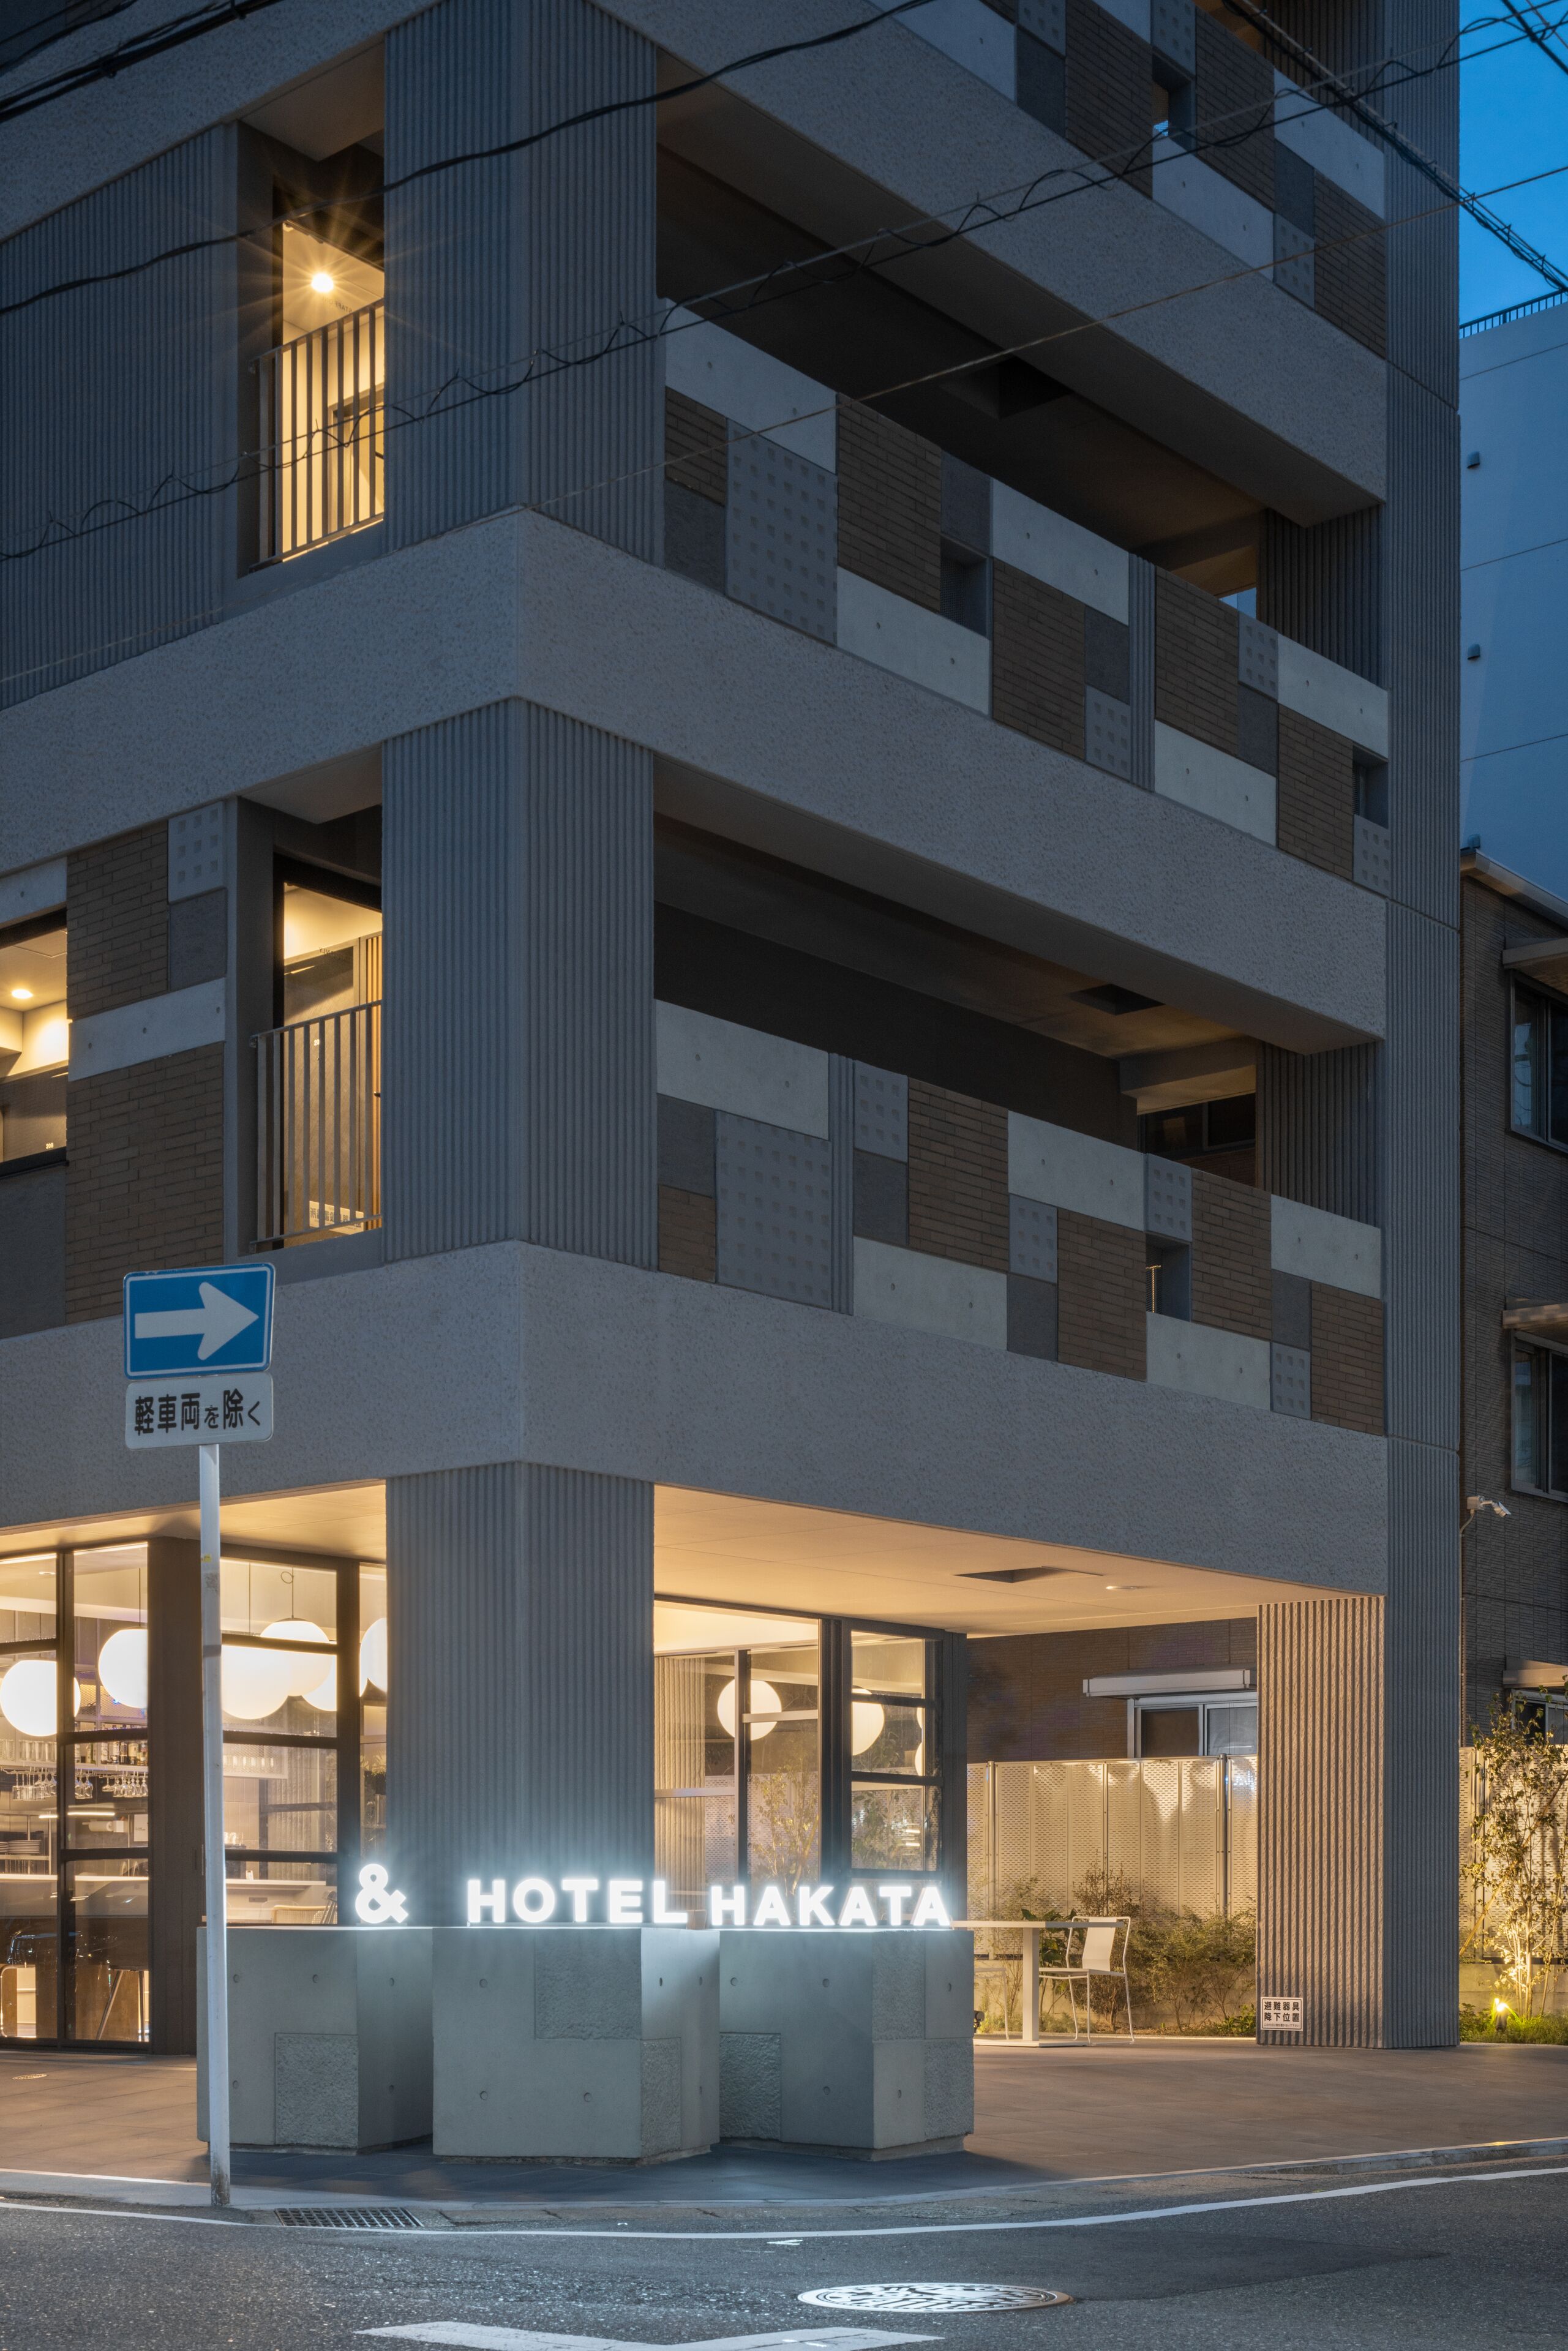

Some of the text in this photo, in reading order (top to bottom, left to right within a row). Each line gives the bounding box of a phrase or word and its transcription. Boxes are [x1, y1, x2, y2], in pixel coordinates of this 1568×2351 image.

[134, 1388, 261, 1436] 軽車両を除く
[354, 1863, 951, 1925] & HOTEL HAKATA
[1264, 2001, 1300, 2011] 避難器具
[1264, 2012, 1300, 2022] 降下位置
